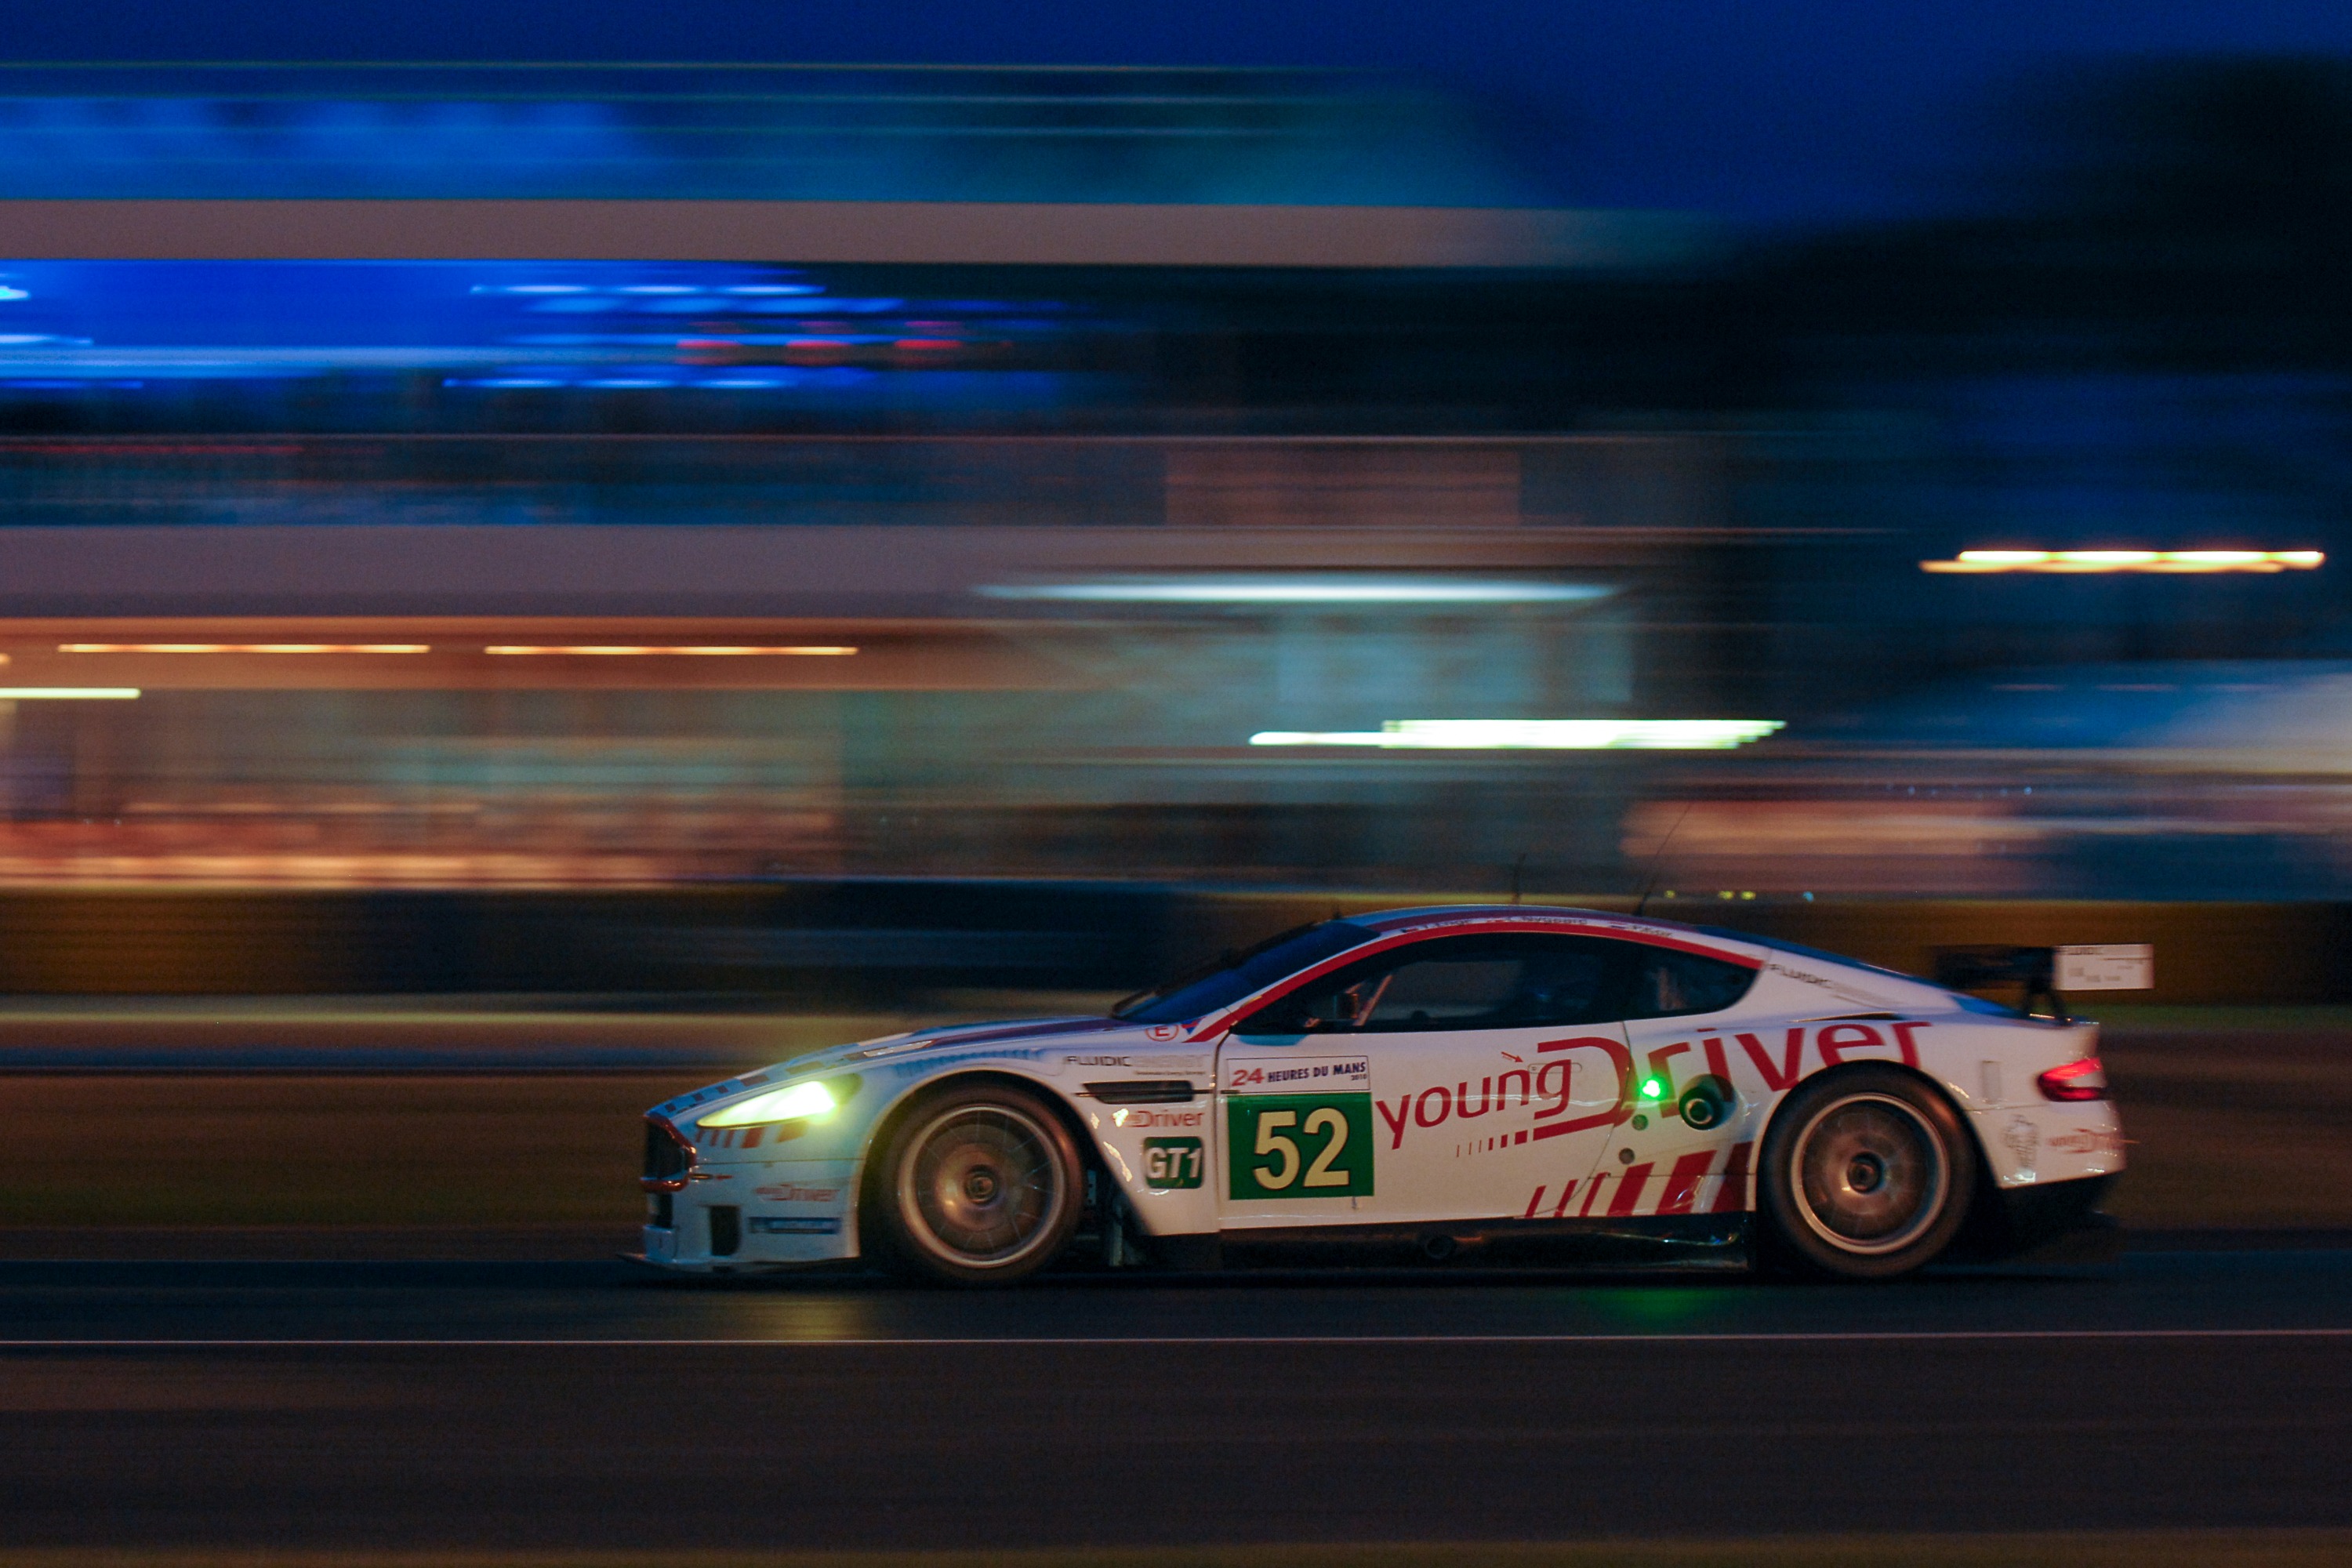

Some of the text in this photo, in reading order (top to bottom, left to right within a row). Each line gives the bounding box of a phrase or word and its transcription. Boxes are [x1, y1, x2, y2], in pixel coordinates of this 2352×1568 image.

[1064, 1056, 1132, 1066] FLUIDIC
[1231, 1062, 1367, 1087] 24 HEURES DU MANS
[1375, 1021, 1932, 1150] young Driver
[1124, 1109, 1205, 1127] Driver
[1254, 1107, 1350, 1191] 52
[1147, 1148, 1202, 1178] GT1
